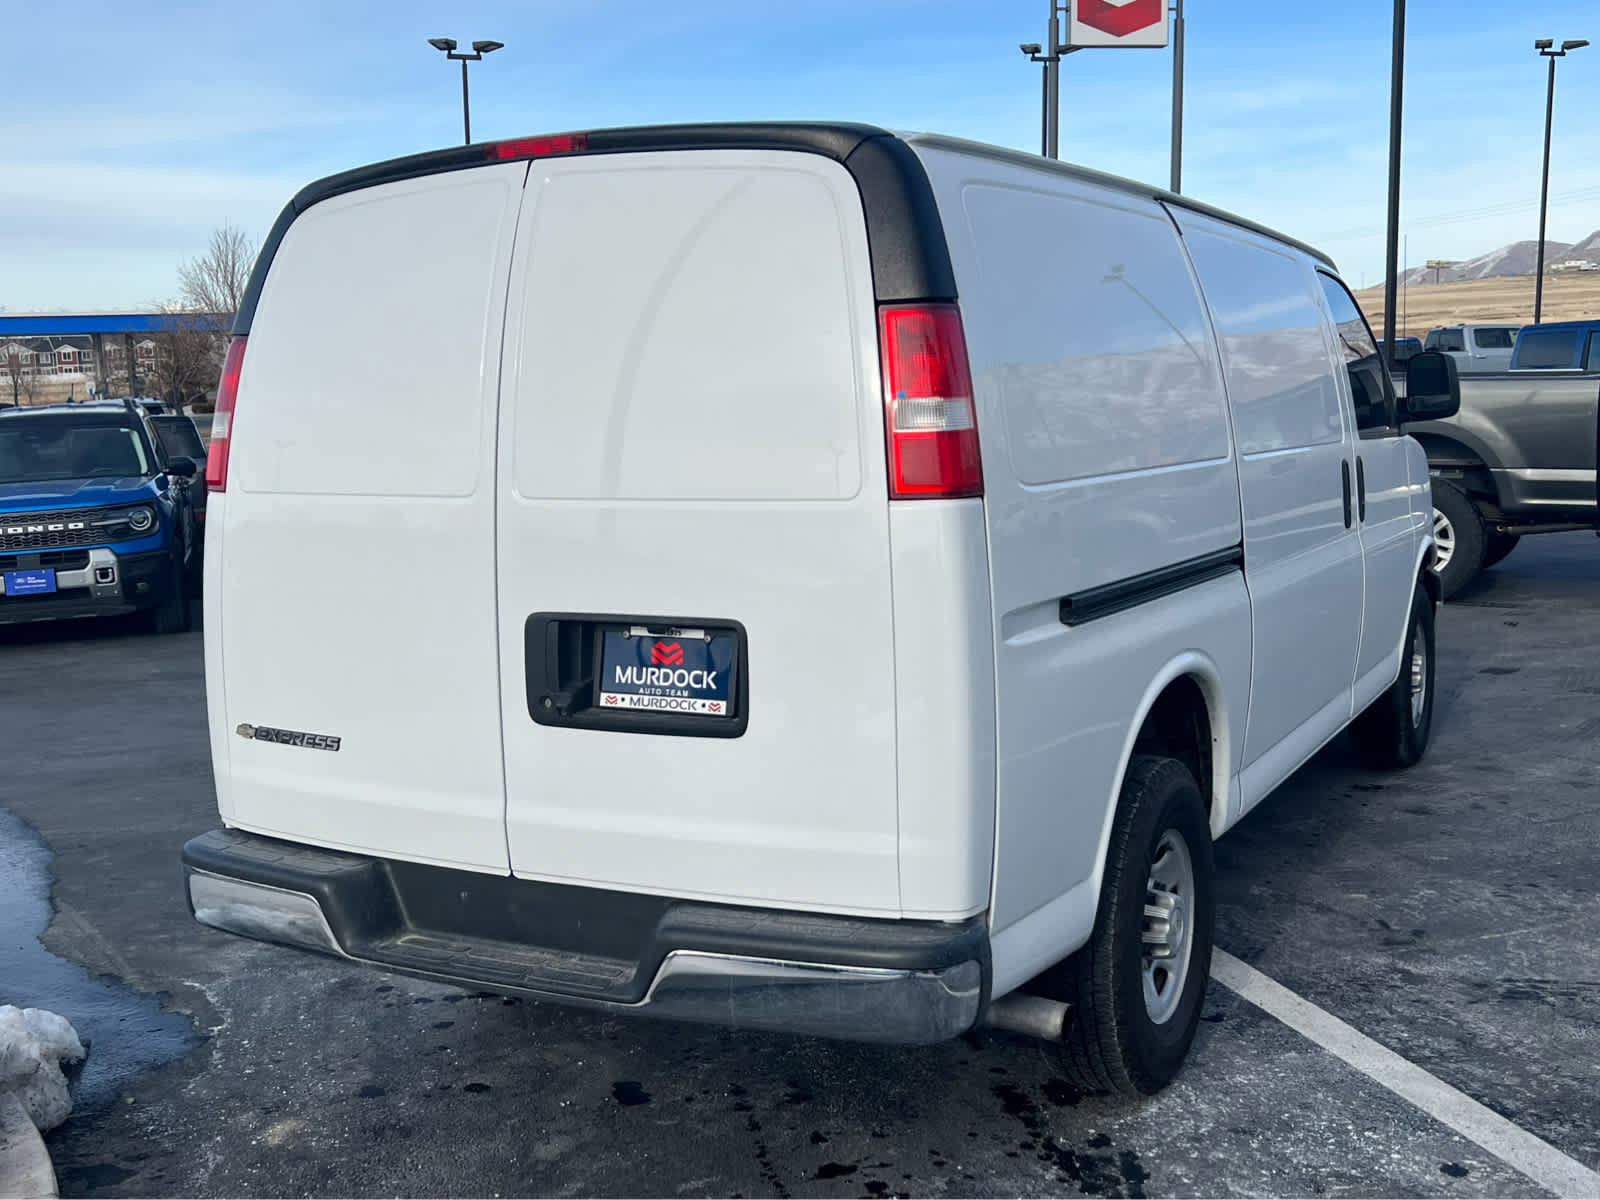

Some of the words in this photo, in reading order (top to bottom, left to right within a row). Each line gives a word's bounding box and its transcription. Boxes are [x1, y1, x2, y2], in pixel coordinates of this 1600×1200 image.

[0, 522, 84, 535] ONCO
[615, 665, 717, 689] MURDOCK
[638, 687, 662, 695] AUTO
[666, 688, 688, 697] TEAM
[629, 696, 697, 711] MURDOCK
[256, 726, 340, 751] EXPRESS
